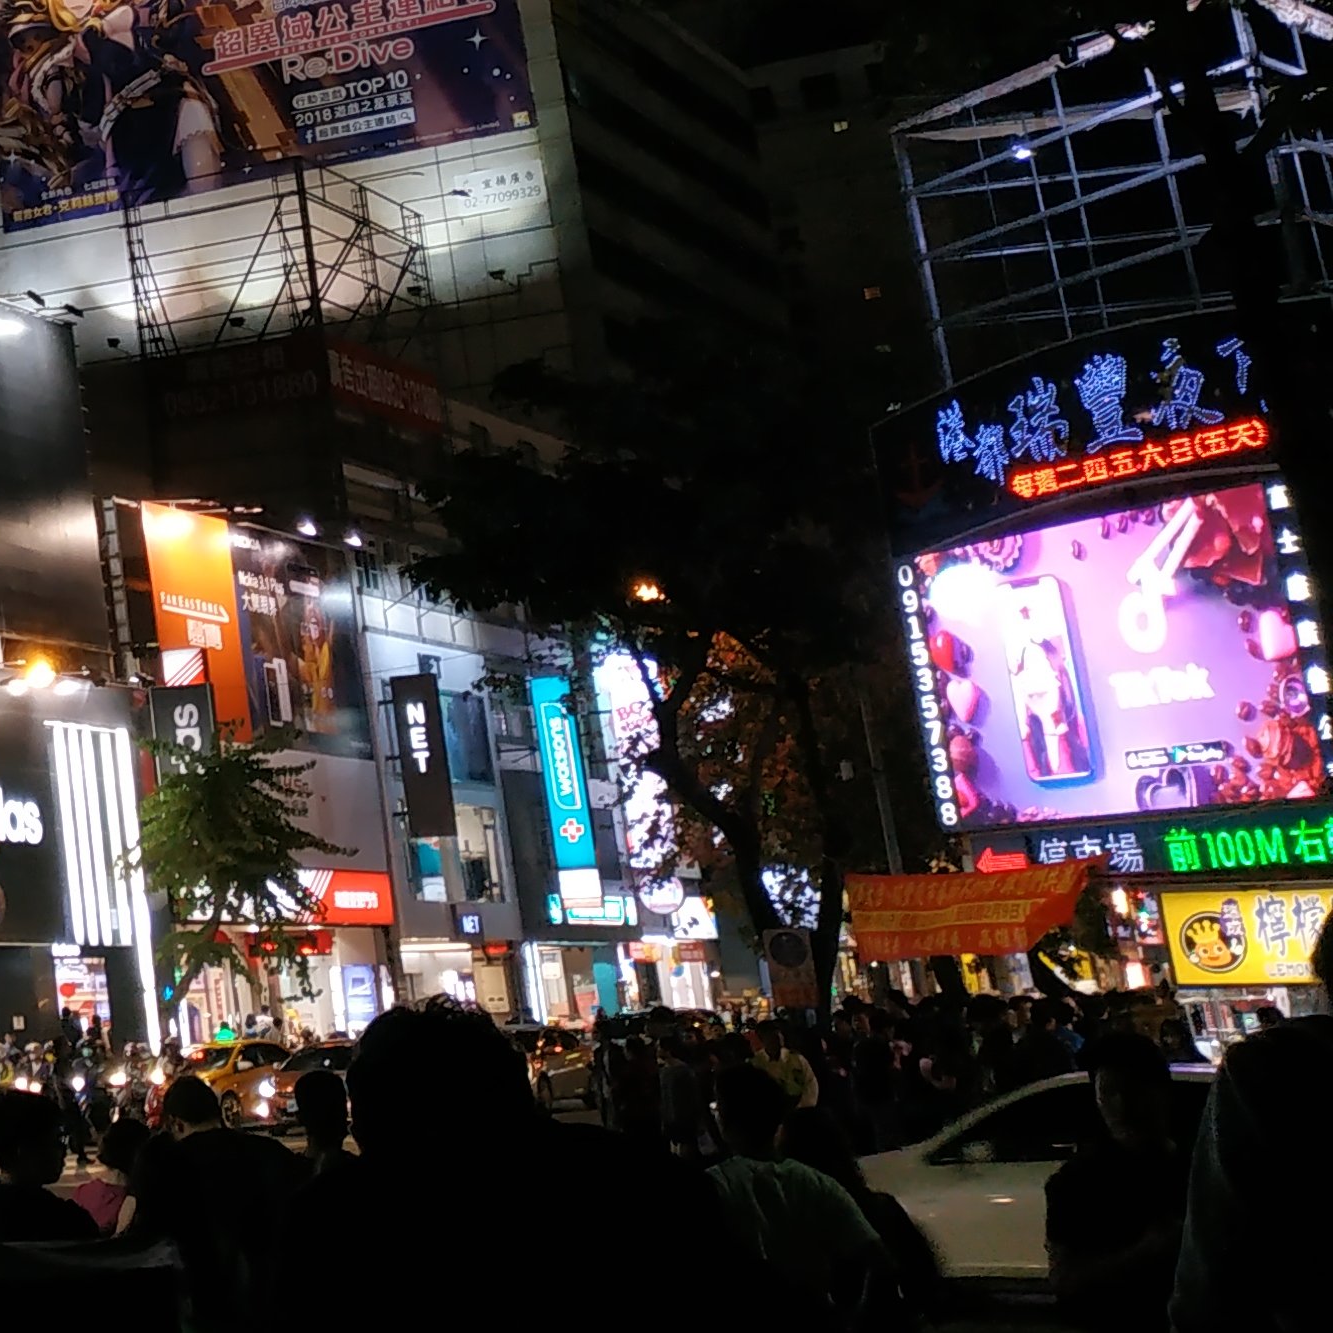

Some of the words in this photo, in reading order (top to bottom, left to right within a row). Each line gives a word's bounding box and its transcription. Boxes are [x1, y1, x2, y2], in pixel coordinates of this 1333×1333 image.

[294, 108, 333, 127] 2018
[345, 77, 385, 98] TOP
[386, 70, 408, 90] 10
[897, 564, 958, 826] 0915357388
[405, 701, 430, 774] NET
[549, 717, 573, 797] watsons
